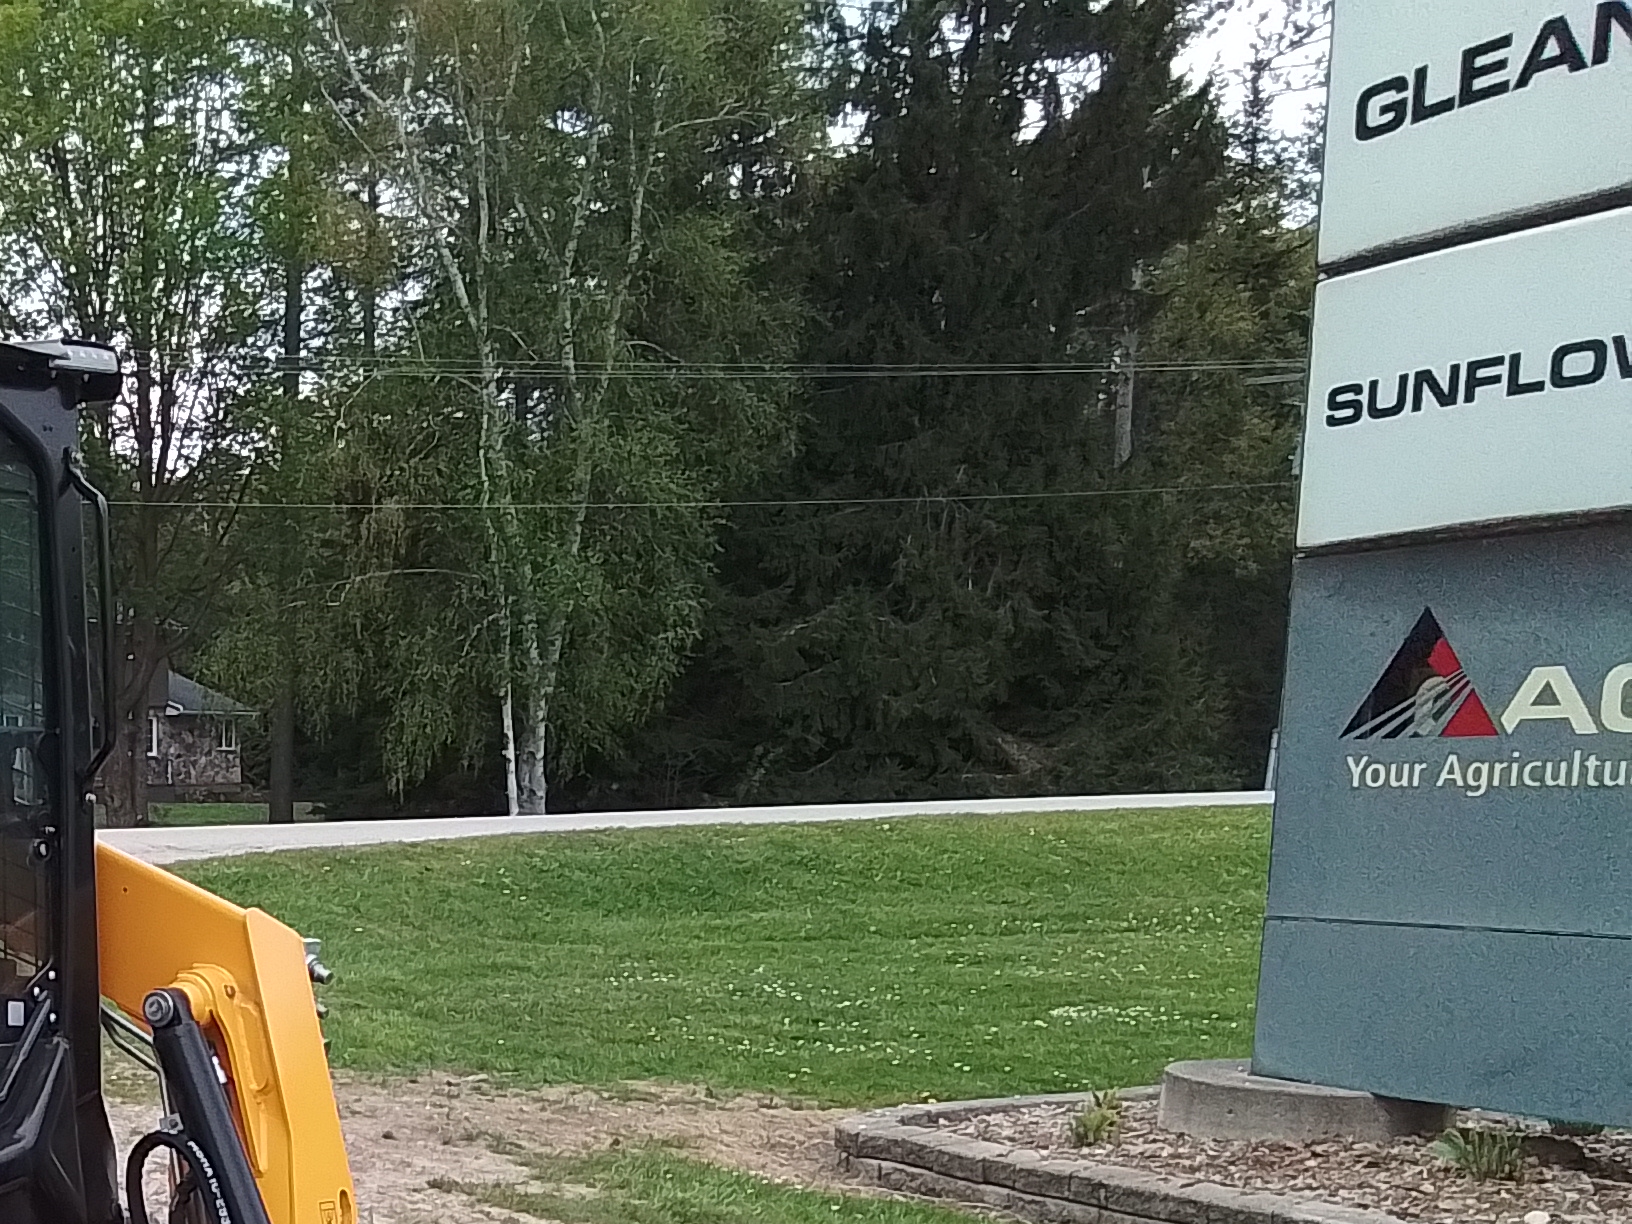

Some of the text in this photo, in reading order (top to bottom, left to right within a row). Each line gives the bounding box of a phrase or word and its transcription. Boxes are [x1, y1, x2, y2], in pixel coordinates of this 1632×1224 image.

[1325, 334, 1632, 428] SUNFLO
[1346, 749, 1632, 797] Your Agricultu
